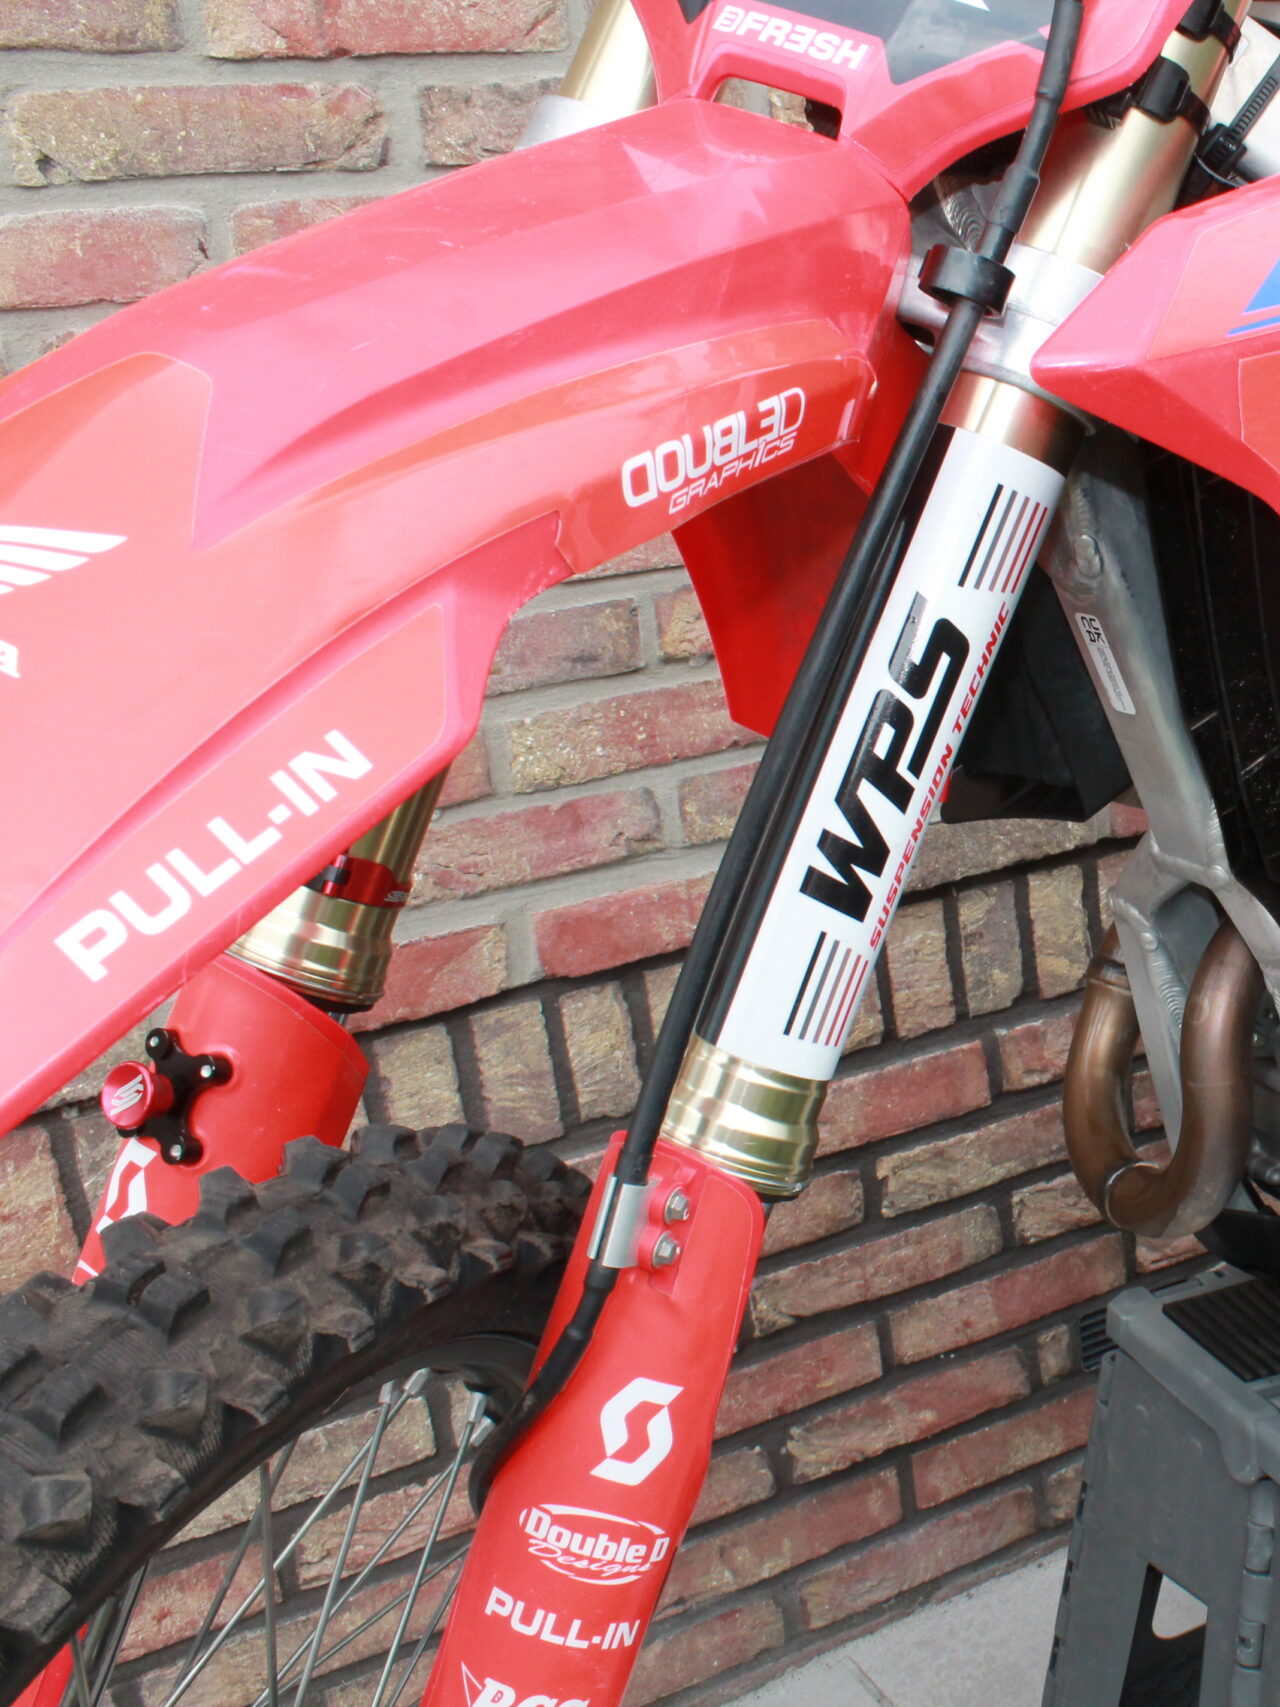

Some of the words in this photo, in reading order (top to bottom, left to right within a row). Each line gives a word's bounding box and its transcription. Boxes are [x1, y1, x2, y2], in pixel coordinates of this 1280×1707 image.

[668, 431, 797, 515] GRAPHICS
[800, 591, 970, 922] WPS
[869, 743, 953, 950] SUSPENSION
[952, 602, 1010, 736] TECHNIC
[53, 729, 374, 983] PULL-IN
[525, 1507, 648, 1563] Double
[650, 1537, 670, 1563] D
[528, 1538, 653, 1577] Designs
[484, 1586, 641, 1650] PULL-IN
